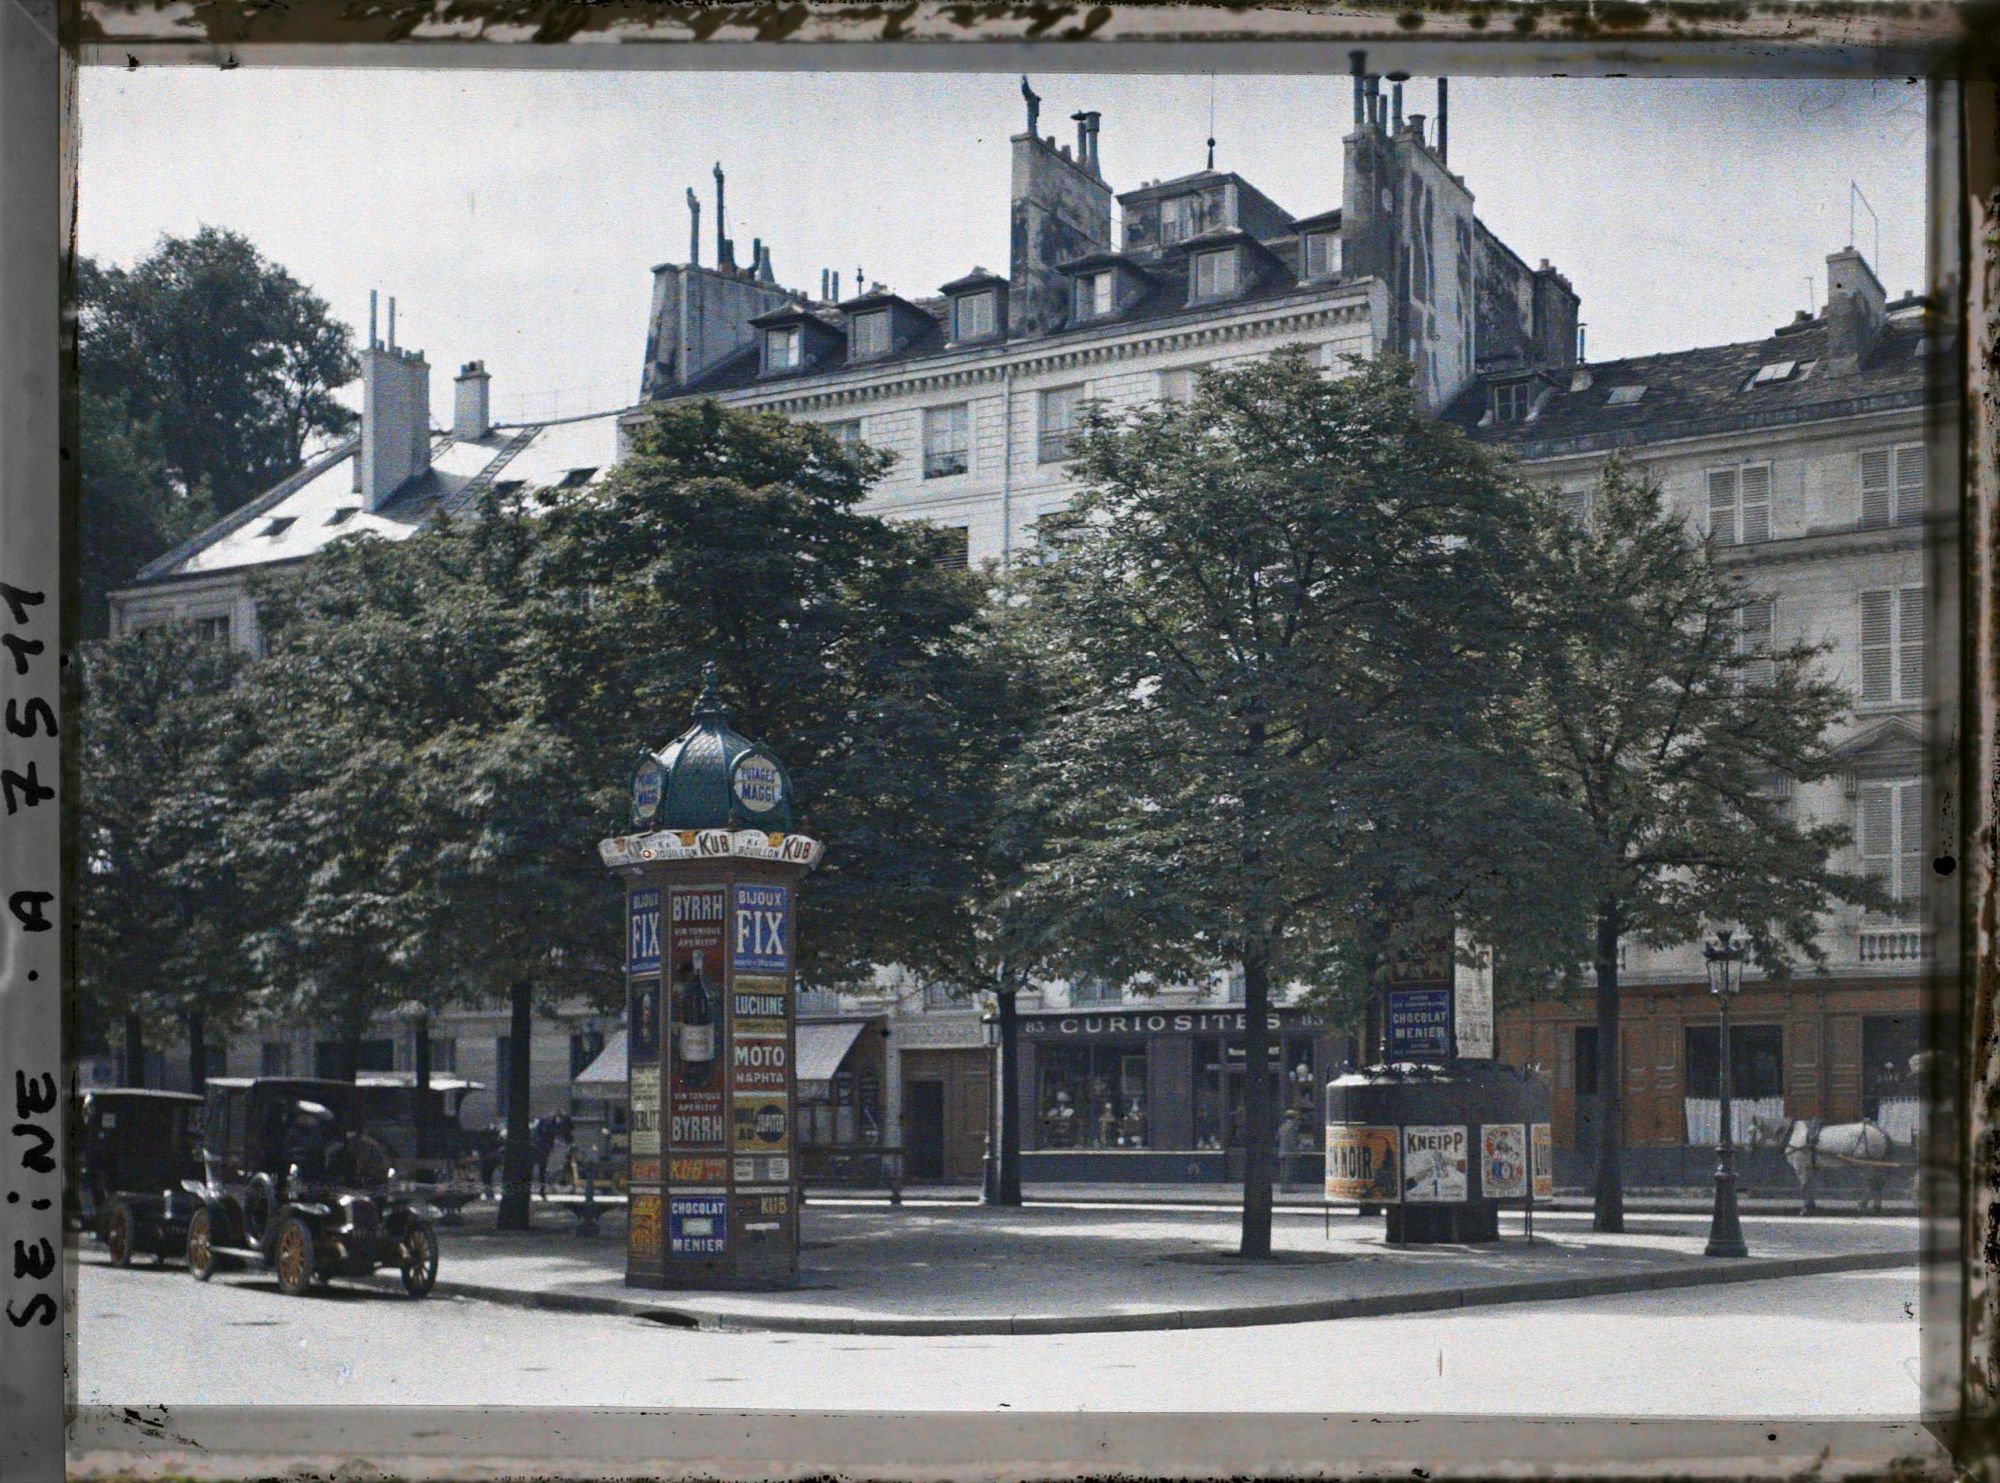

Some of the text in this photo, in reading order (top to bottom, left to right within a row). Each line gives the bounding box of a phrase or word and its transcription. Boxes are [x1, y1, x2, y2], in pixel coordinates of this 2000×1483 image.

[0, 583, 56, 813] 7511
[740, 784, 778, 802] MAGGI
[699, 832, 730, 856] KUB
[738, 845, 779, 858] BOUILLON
[781, 837, 812, 860] KUB
[633, 893, 659, 910] BIJOUX
[672, 894, 723, 922] BYRRH
[738, 890, 782, 906] BIJOUX
[6, 891, 52, 932] A
[631, 911, 661, 960] FIX
[736, 909, 785, 956] FIX
[735, 995, 784, 1016] LUCILINE
[1060, 1014, 1282, 1034] CURIOSITES
[1392, 1011, 1447, 1025] CHOCOLAT
[1394, 1026, 1446, 1040] MENIER
[734, 1046, 785, 1067] MOTO
[736, 1071, 784, 1084] NAPHTA
[672, 1115, 723, 1142] BYRRH
[1407, 1131, 1463, 1154] KNEIPP
[1340, 1145, 1372, 1178] NOIR
[671, 1202, 725, 1215] CHOCOLAT
[761, 1196, 788, 1216] KUB
[672, 1239, 724, 1253] MENIER
